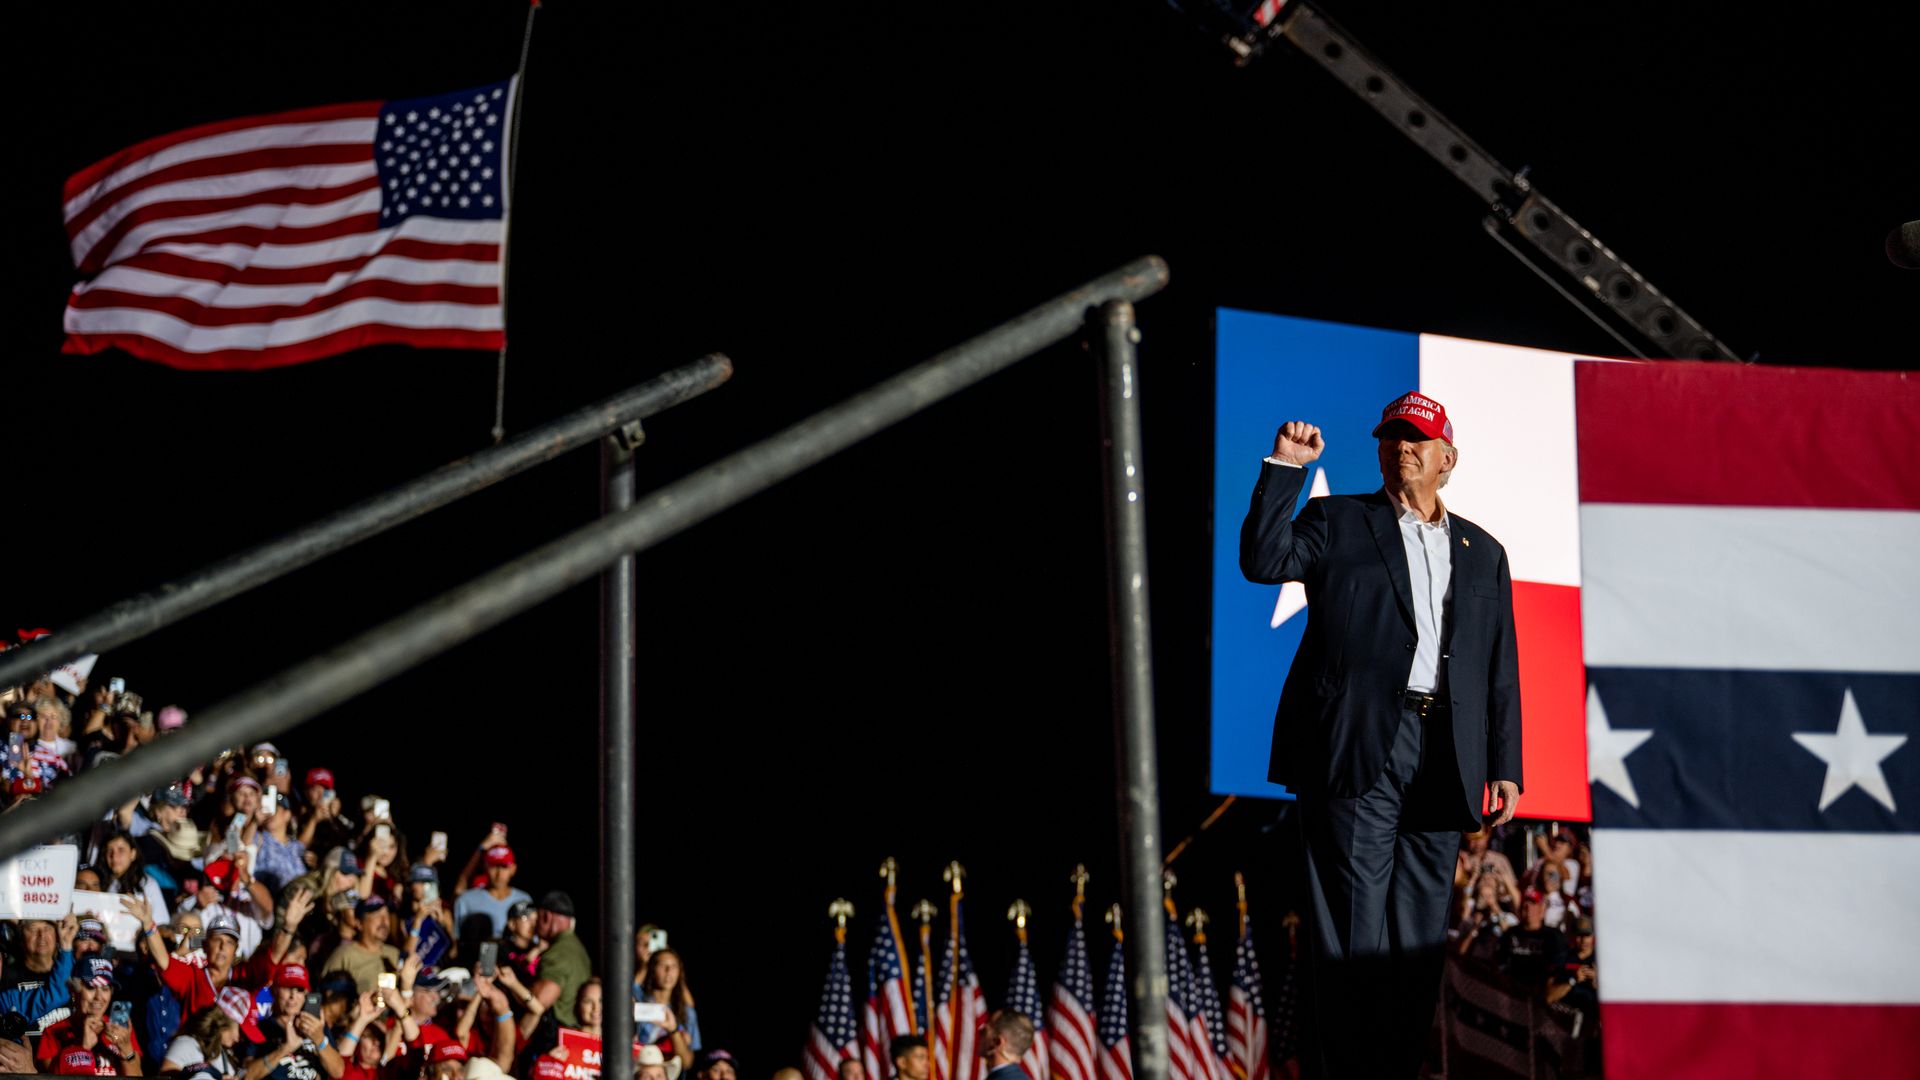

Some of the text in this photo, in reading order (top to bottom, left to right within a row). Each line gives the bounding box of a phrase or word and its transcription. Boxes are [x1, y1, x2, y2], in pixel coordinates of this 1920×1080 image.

[1403, 395, 1441, 413] AMERICA
[1408, 406, 1435, 422] AGAIN
[18, 859, 48, 870] TEXT
[20, 876, 55, 887] RUMP
[23, 892, 60, 904] 88022
